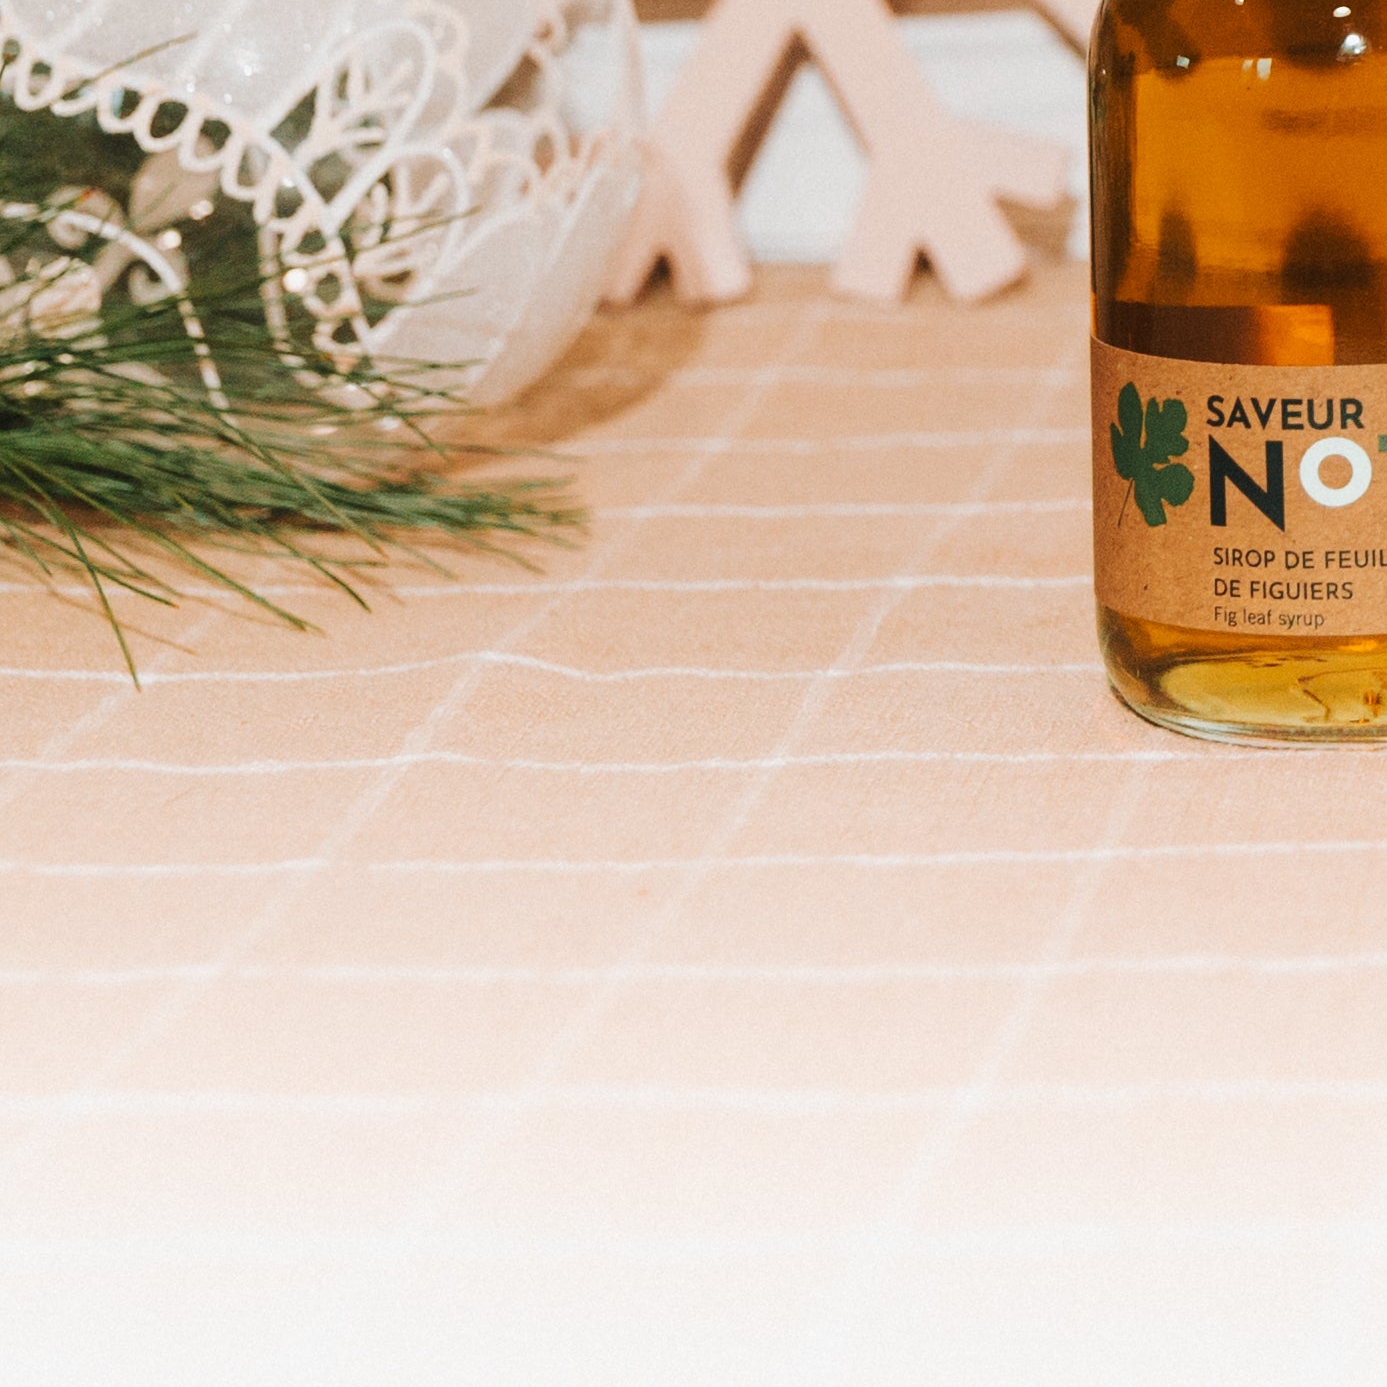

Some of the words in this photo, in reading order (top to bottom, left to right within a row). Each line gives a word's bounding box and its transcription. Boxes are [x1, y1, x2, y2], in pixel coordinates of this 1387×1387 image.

[1206, 395, 1365, 430] SAVEUR
[1213, 547, 1276, 568] SIROP
[1285, 549, 1316, 569] DE
[1214, 579, 1241, 598] DE
[1250, 581, 1353, 601] FIGUIERS
[1214, 606, 1237, 626] Fig
[1243, 608, 1272, 625] leaf
[1279, 611, 1325, 629] syrup
